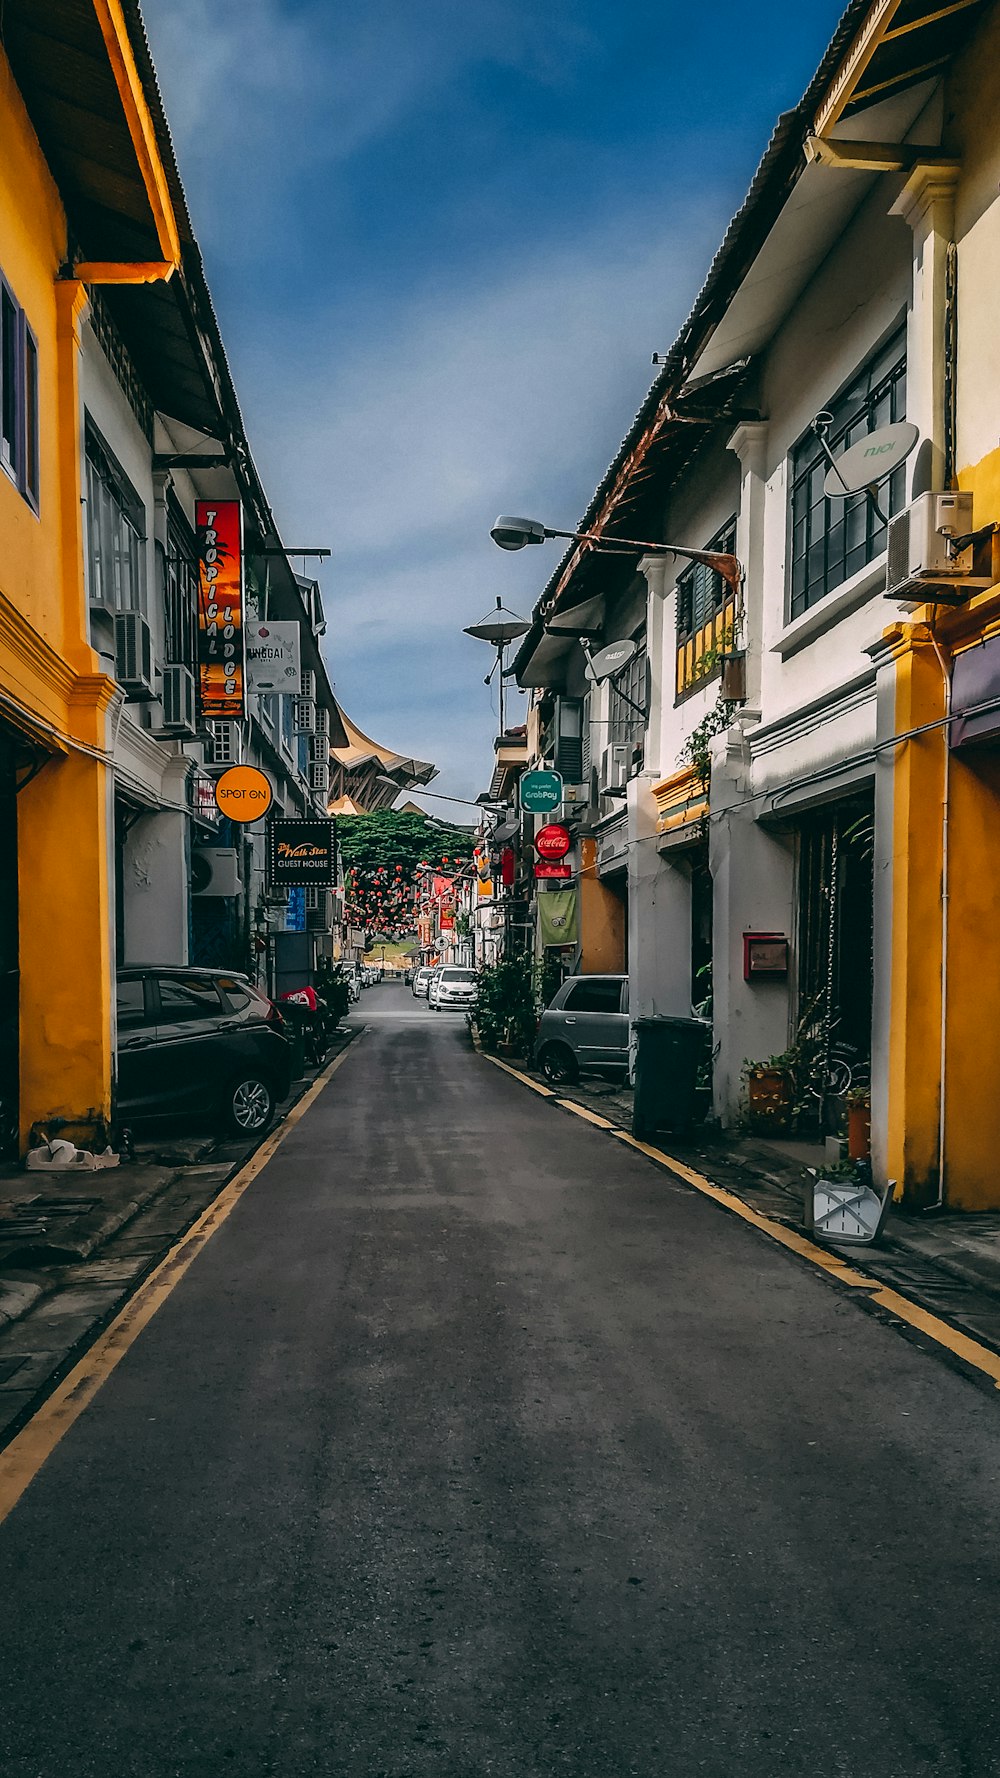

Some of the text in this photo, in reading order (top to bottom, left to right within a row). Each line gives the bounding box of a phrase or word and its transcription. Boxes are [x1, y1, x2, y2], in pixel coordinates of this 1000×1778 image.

[205, 511, 218, 655] TROPICAL
[223, 606, 237, 694] LODGE
[220, 789, 267, 799] SPOT ON
[525, 791, 558, 801] GrabPay
[277, 860, 329, 868] GUEST HOUSE
